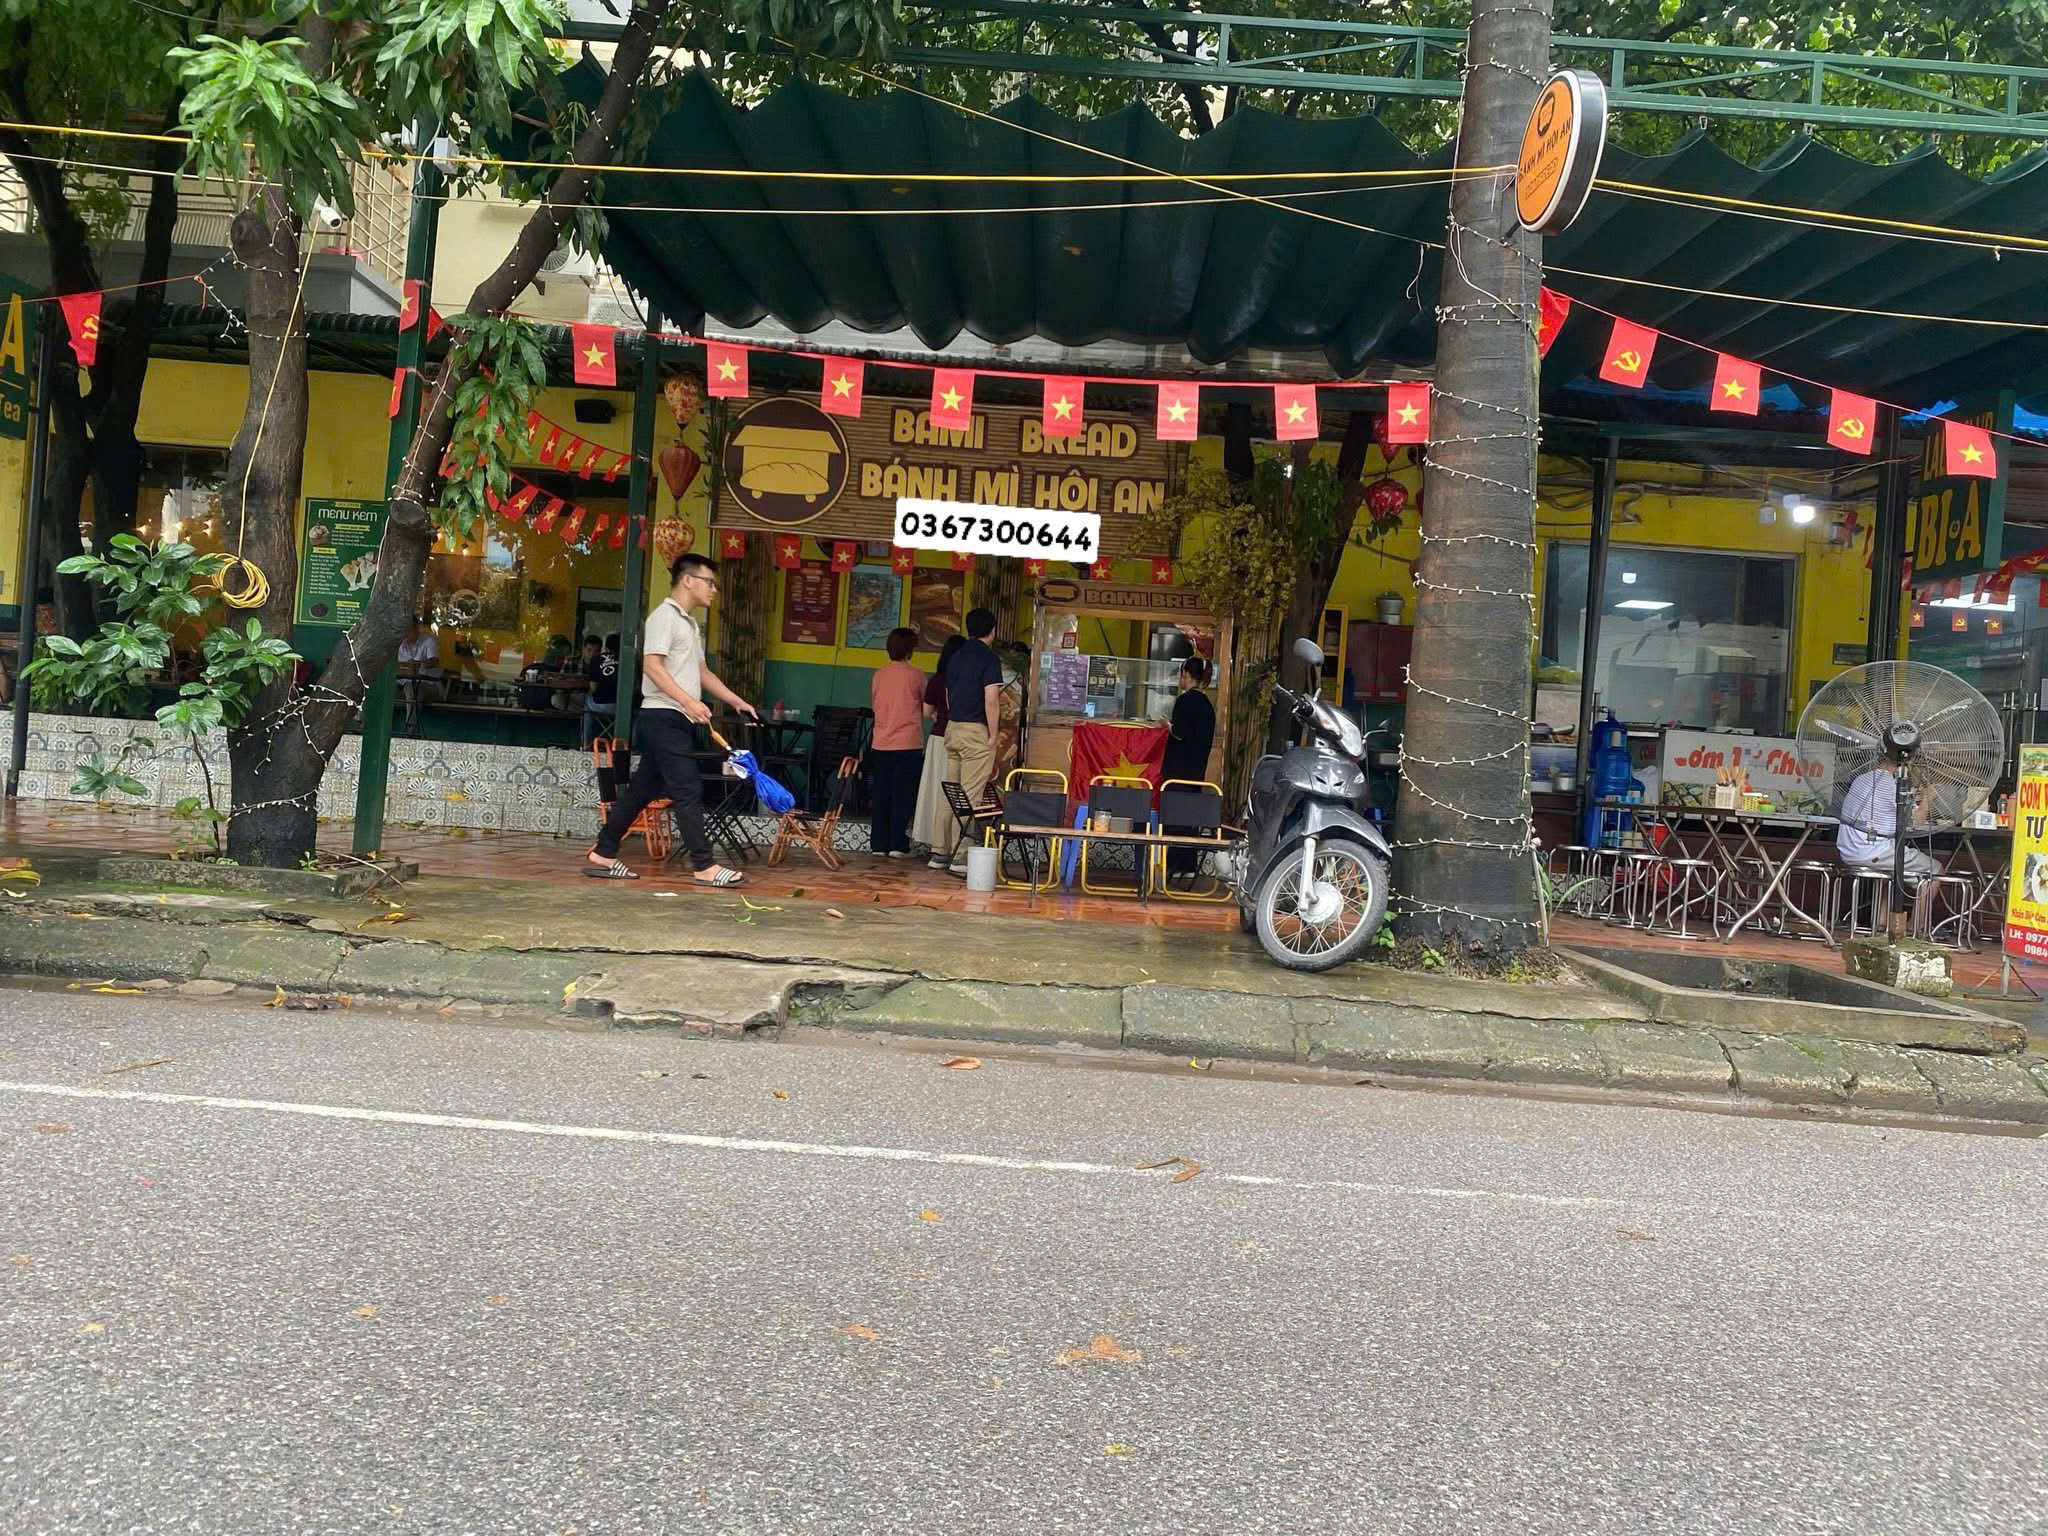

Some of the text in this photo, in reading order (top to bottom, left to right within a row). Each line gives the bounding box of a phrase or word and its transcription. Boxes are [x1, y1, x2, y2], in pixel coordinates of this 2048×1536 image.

[893, 408, 1137, 458] BAMI BREAD
[860, 458, 957, 501] BÁNH
[974, 465, 1021, 507] MÌ
[1113, 480, 1165, 514] AN
[1085, 588, 1210, 610] BAMI BRE
[2026, 815, 2047, 844] TỰ
[2009, 928, 2024, 940] LH:
